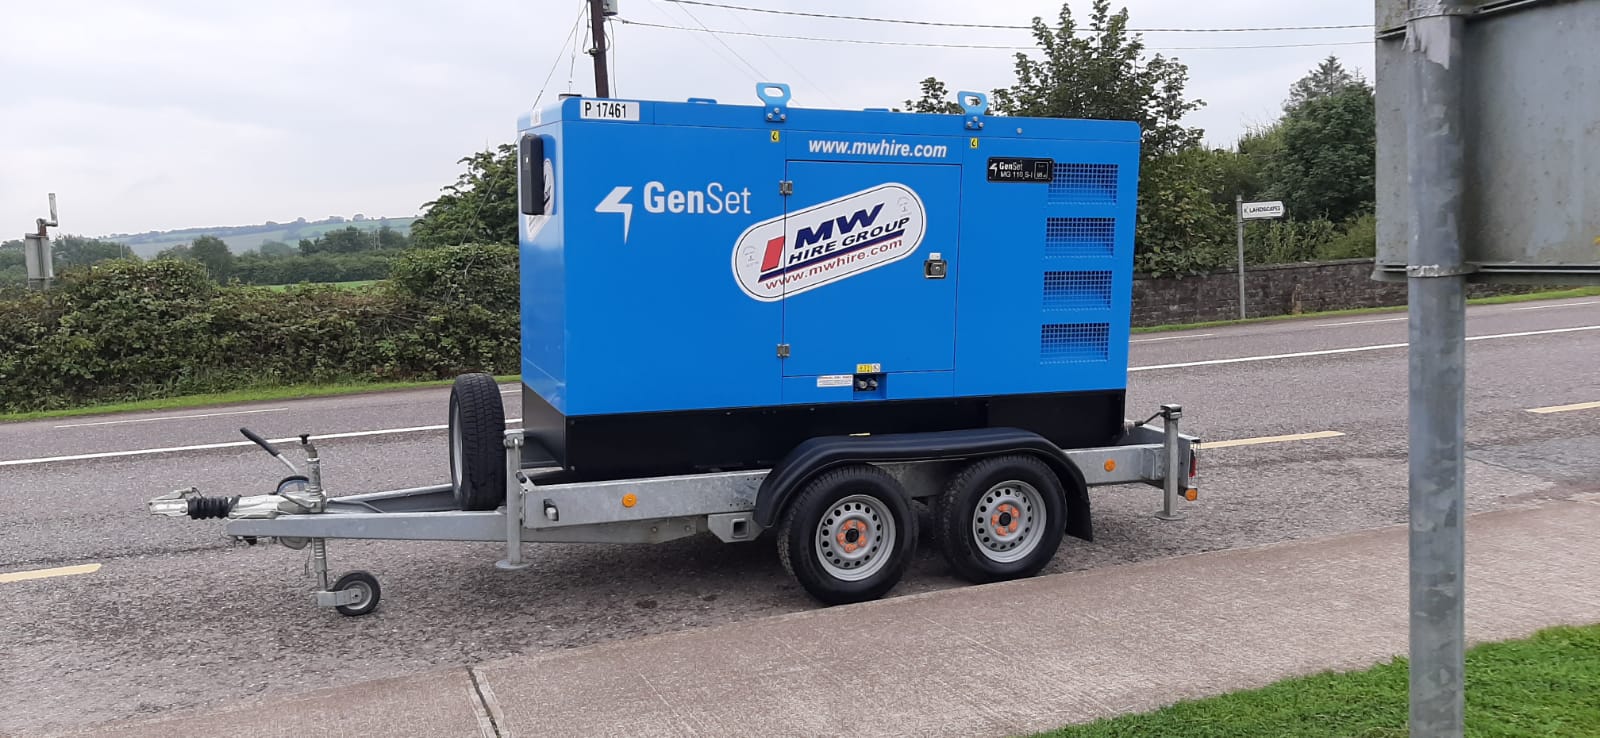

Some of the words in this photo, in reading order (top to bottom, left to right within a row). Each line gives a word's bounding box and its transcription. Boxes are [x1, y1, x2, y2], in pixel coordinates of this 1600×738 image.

[584, 101, 592, 117] P
[596, 102, 626, 118] 17461
[808, 139, 947, 158] www.mwhire.com
[999, 161, 1023, 171] GenSet
[643, 180, 752, 214] GenSet
[788, 241, 837, 265] HIRE
[842, 216, 910, 248] GROUP
[794, 202, 885, 250] MW
[765, 238, 903, 290] www.mwhire.com
